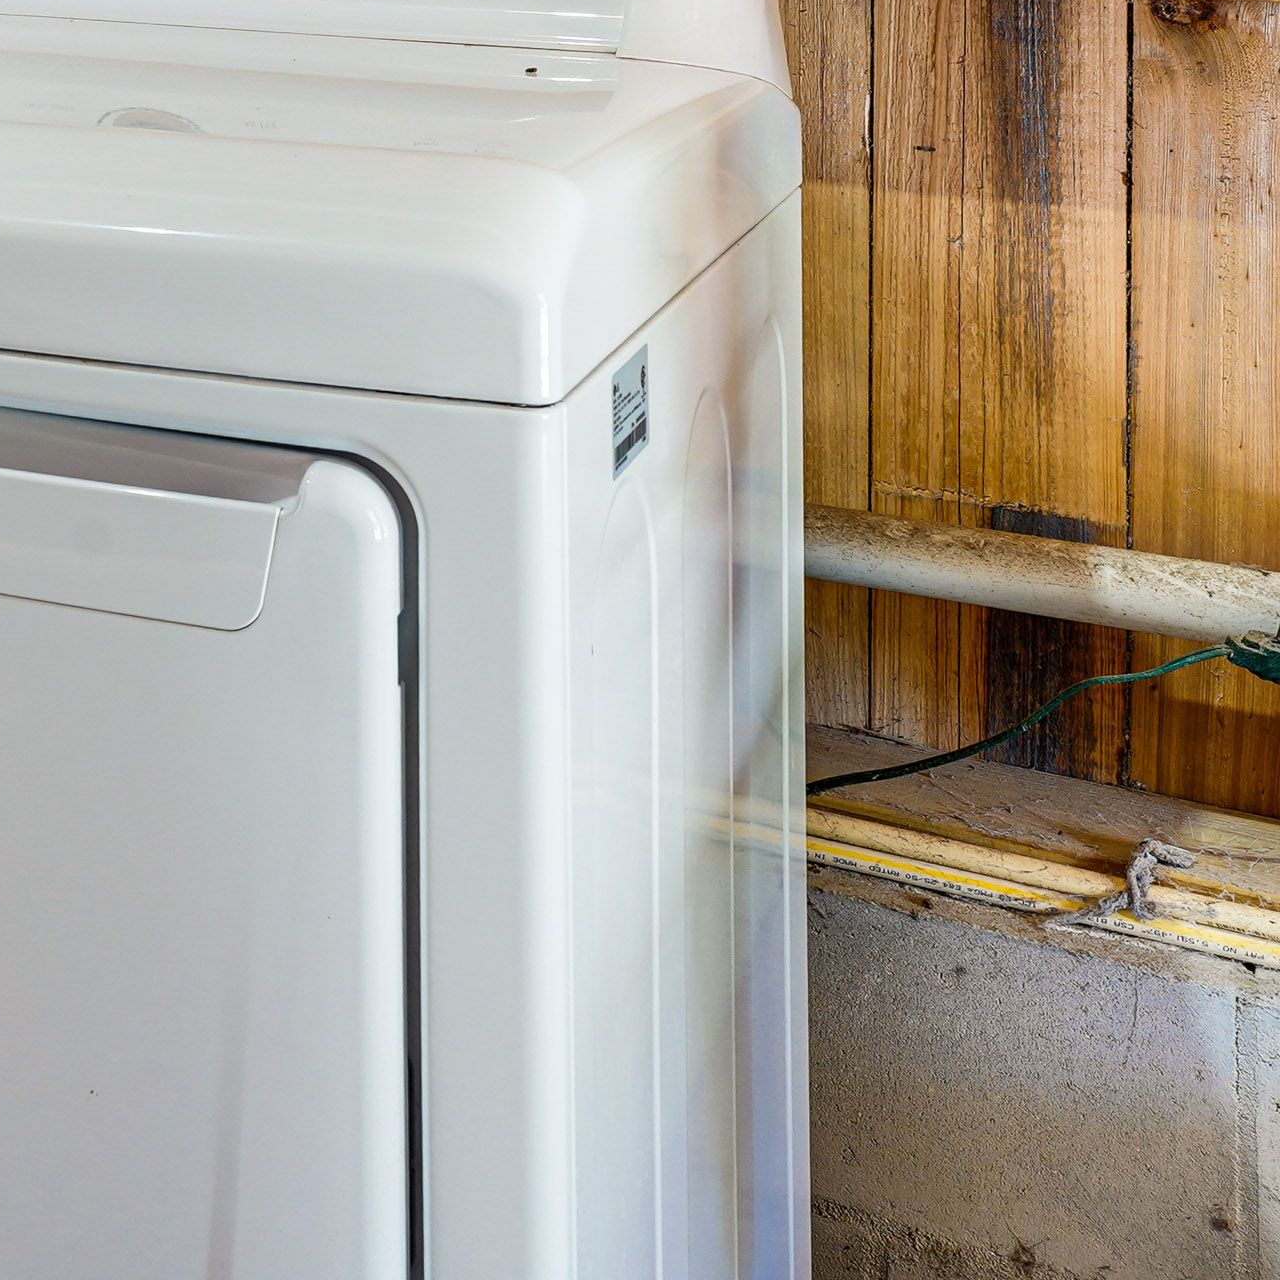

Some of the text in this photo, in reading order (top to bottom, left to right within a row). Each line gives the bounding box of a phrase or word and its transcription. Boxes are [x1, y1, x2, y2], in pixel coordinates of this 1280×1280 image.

[814, 852, 826, 861] IN
[831, 856, 858, 867] MADE
[868, 864, 900, 878] RATED
[905, 873, 938, 886] 25/50
[1113, 920, 1135, 931] CSA
